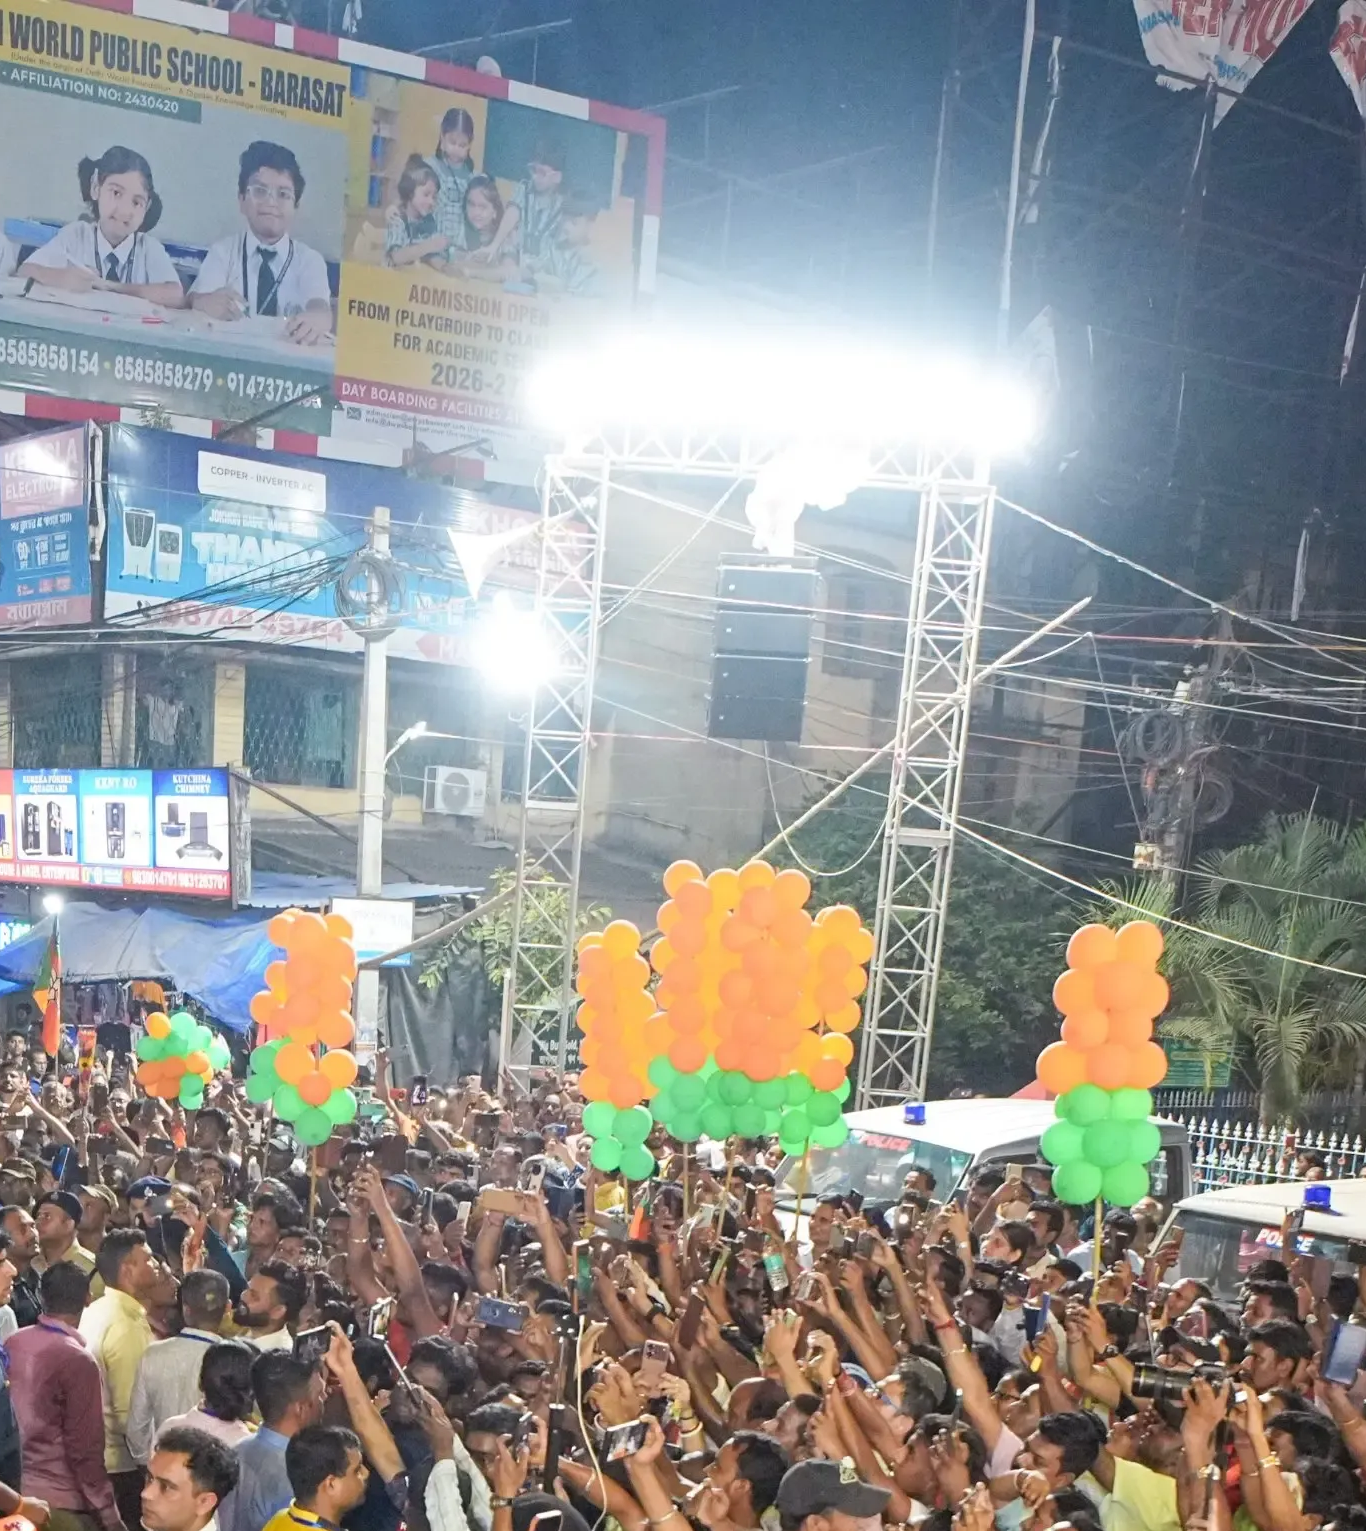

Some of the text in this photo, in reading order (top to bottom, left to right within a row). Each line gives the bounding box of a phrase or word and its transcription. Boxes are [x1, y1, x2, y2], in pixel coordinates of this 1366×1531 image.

[9, 12, 84, 62] WORLD
[90, 29, 162, 79] PUBLIC
[167, 46, 243, 97] SCHOOL
[261, 66, 346, 118] BARASAT
[11, 68, 94, 98] AFFILIATION
[98, 87, 121, 102] NO:
[124, 91, 179, 115] 2430420
[408, 284, 502, 320] ADMISSION
[348, 299, 391, 323] FROM
[395, 308, 483, 339] (PLAYGROUP
[486, 325, 504, 345] TO
[393, 332, 422, 352] FOR
[425, 341, 499, 369] ACADEMIC
[114, 354, 213, 393] 8585858279
[342, 382, 366, 399] DAY
[370, 385, 437, 412] BOARDING
[441, 399, 502, 422] FACILITIES
[211, 465, 248, 481] COPPER
[256, 475, 300, 490] INVERTER
[302, 482, 314, 493] AC
[95, 776, 138, 790] KENT RO
[172, 774, 212, 785] KUTCHINA
[175, 783, 211, 794] CHIMNEY
